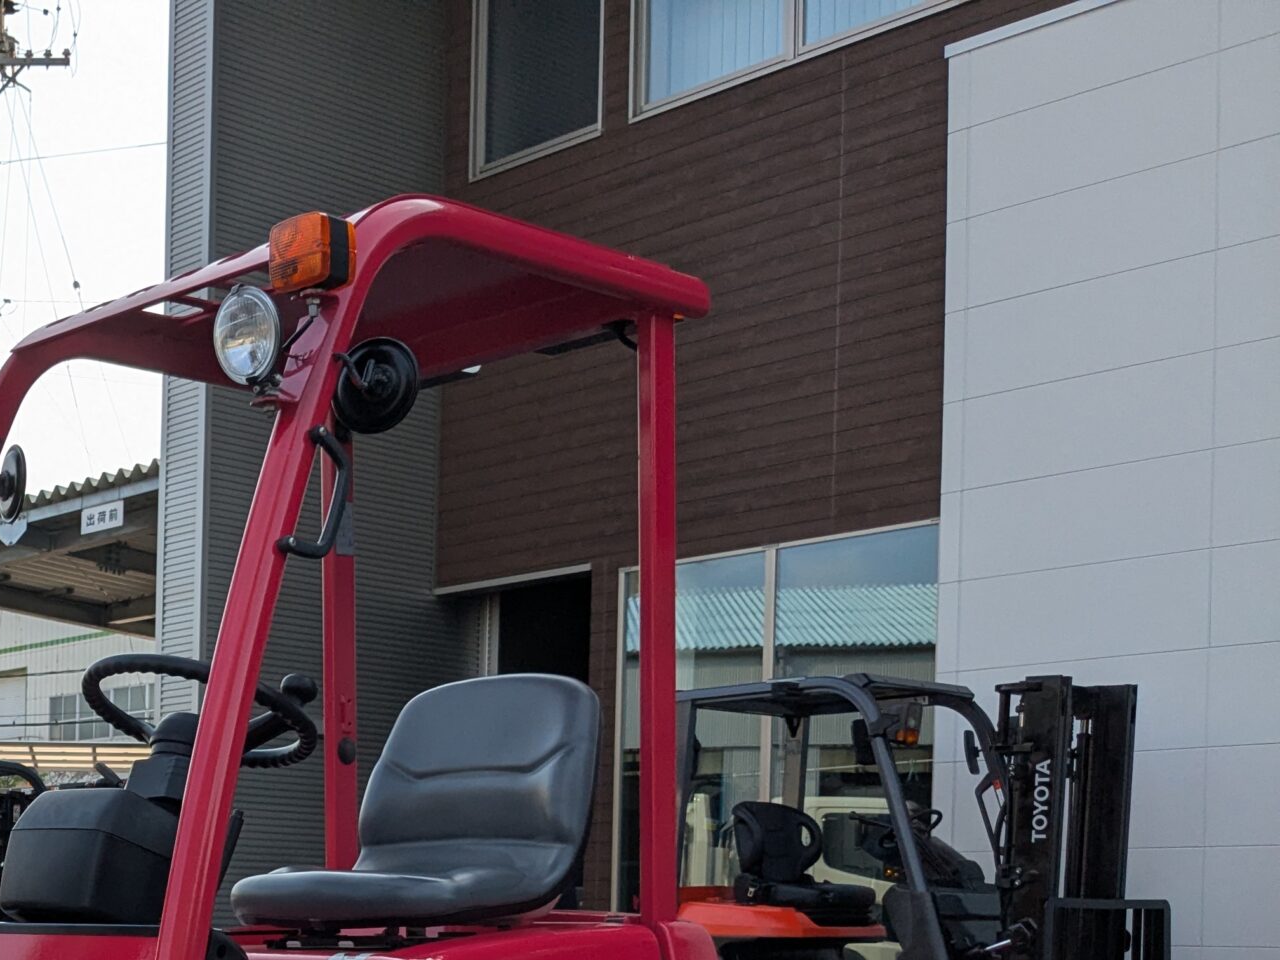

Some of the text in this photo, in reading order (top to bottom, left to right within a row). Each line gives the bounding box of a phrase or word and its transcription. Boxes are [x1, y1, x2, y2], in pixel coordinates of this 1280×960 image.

[86, 508, 119, 528] 出荷前
[1031, 758, 1052, 844] TOYOTA
